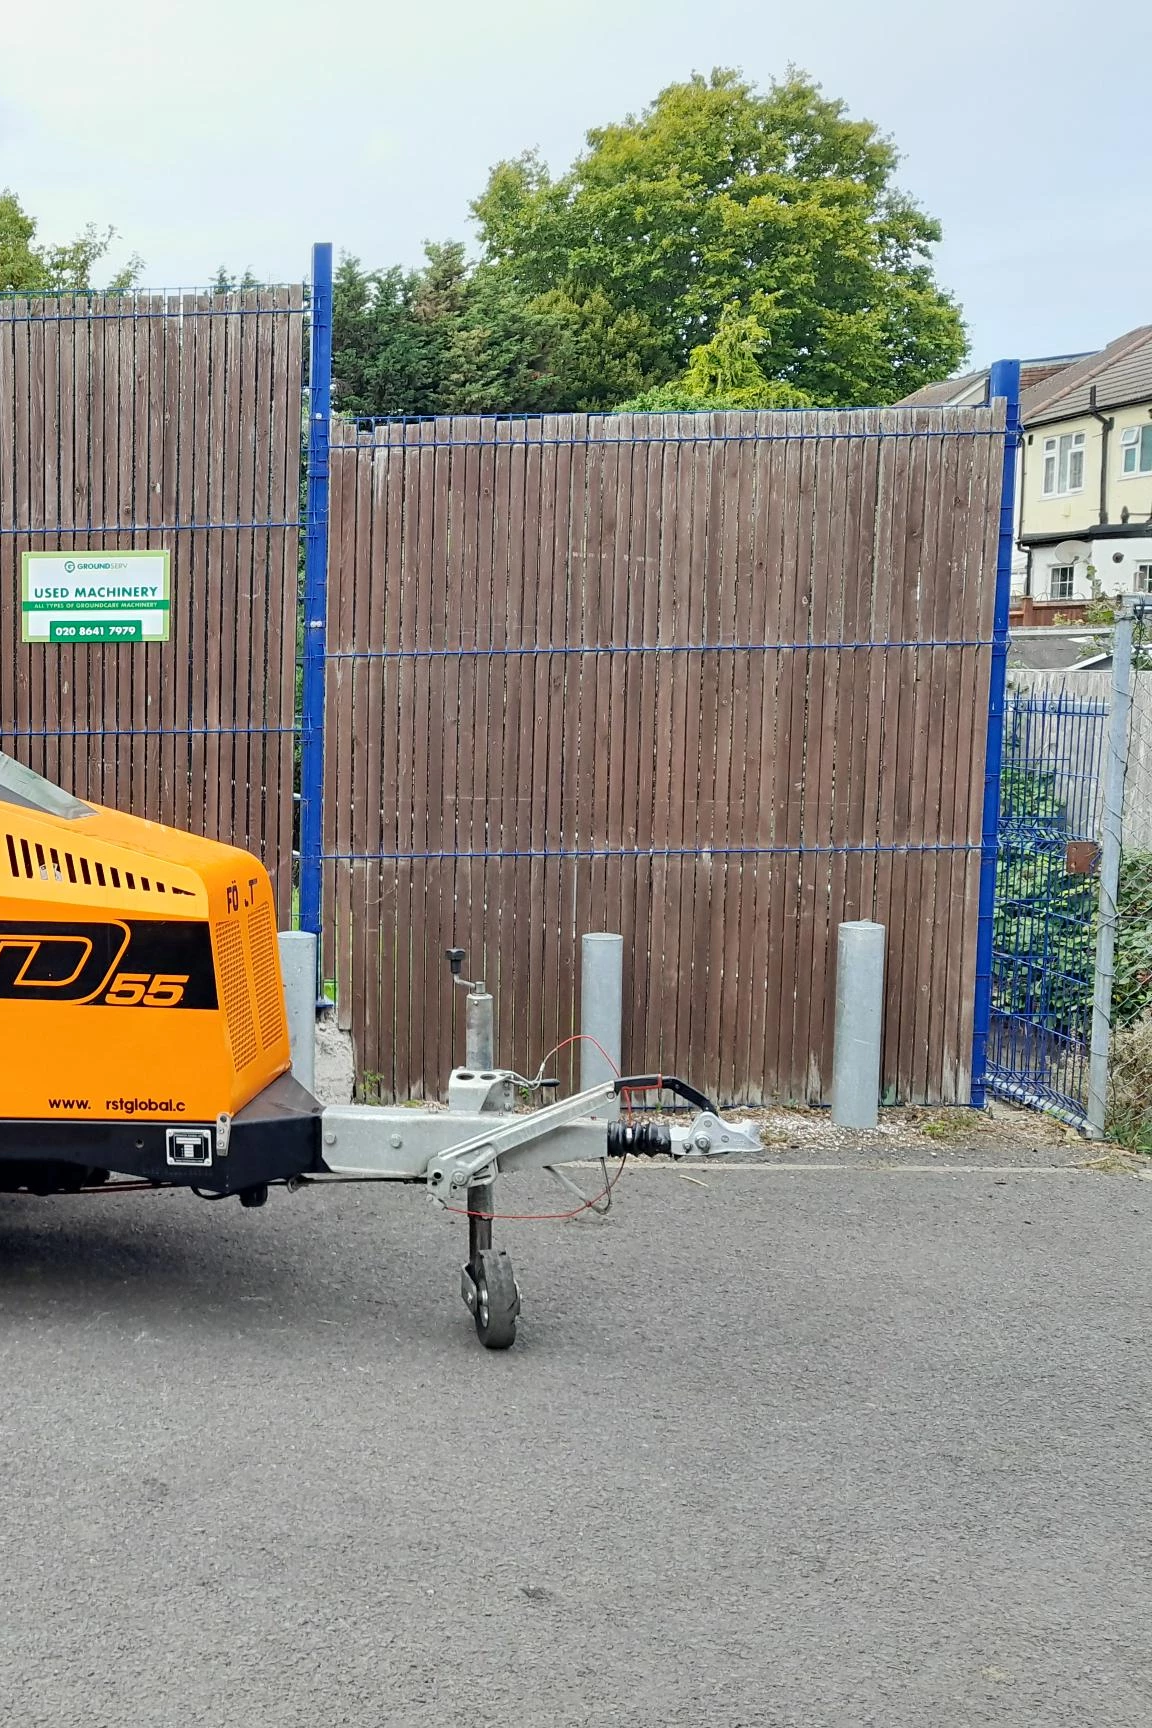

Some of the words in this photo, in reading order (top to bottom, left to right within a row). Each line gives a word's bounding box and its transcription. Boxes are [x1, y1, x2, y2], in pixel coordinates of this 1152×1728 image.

[34, 587, 70, 599] USED
[74, 586, 158, 598] MACHINERY
[55, 627, 76, 636] 020
[79, 626, 105, 636] 8641
[108, 626, 136, 635] 7979
[105, 973, 189, 1007] 55
